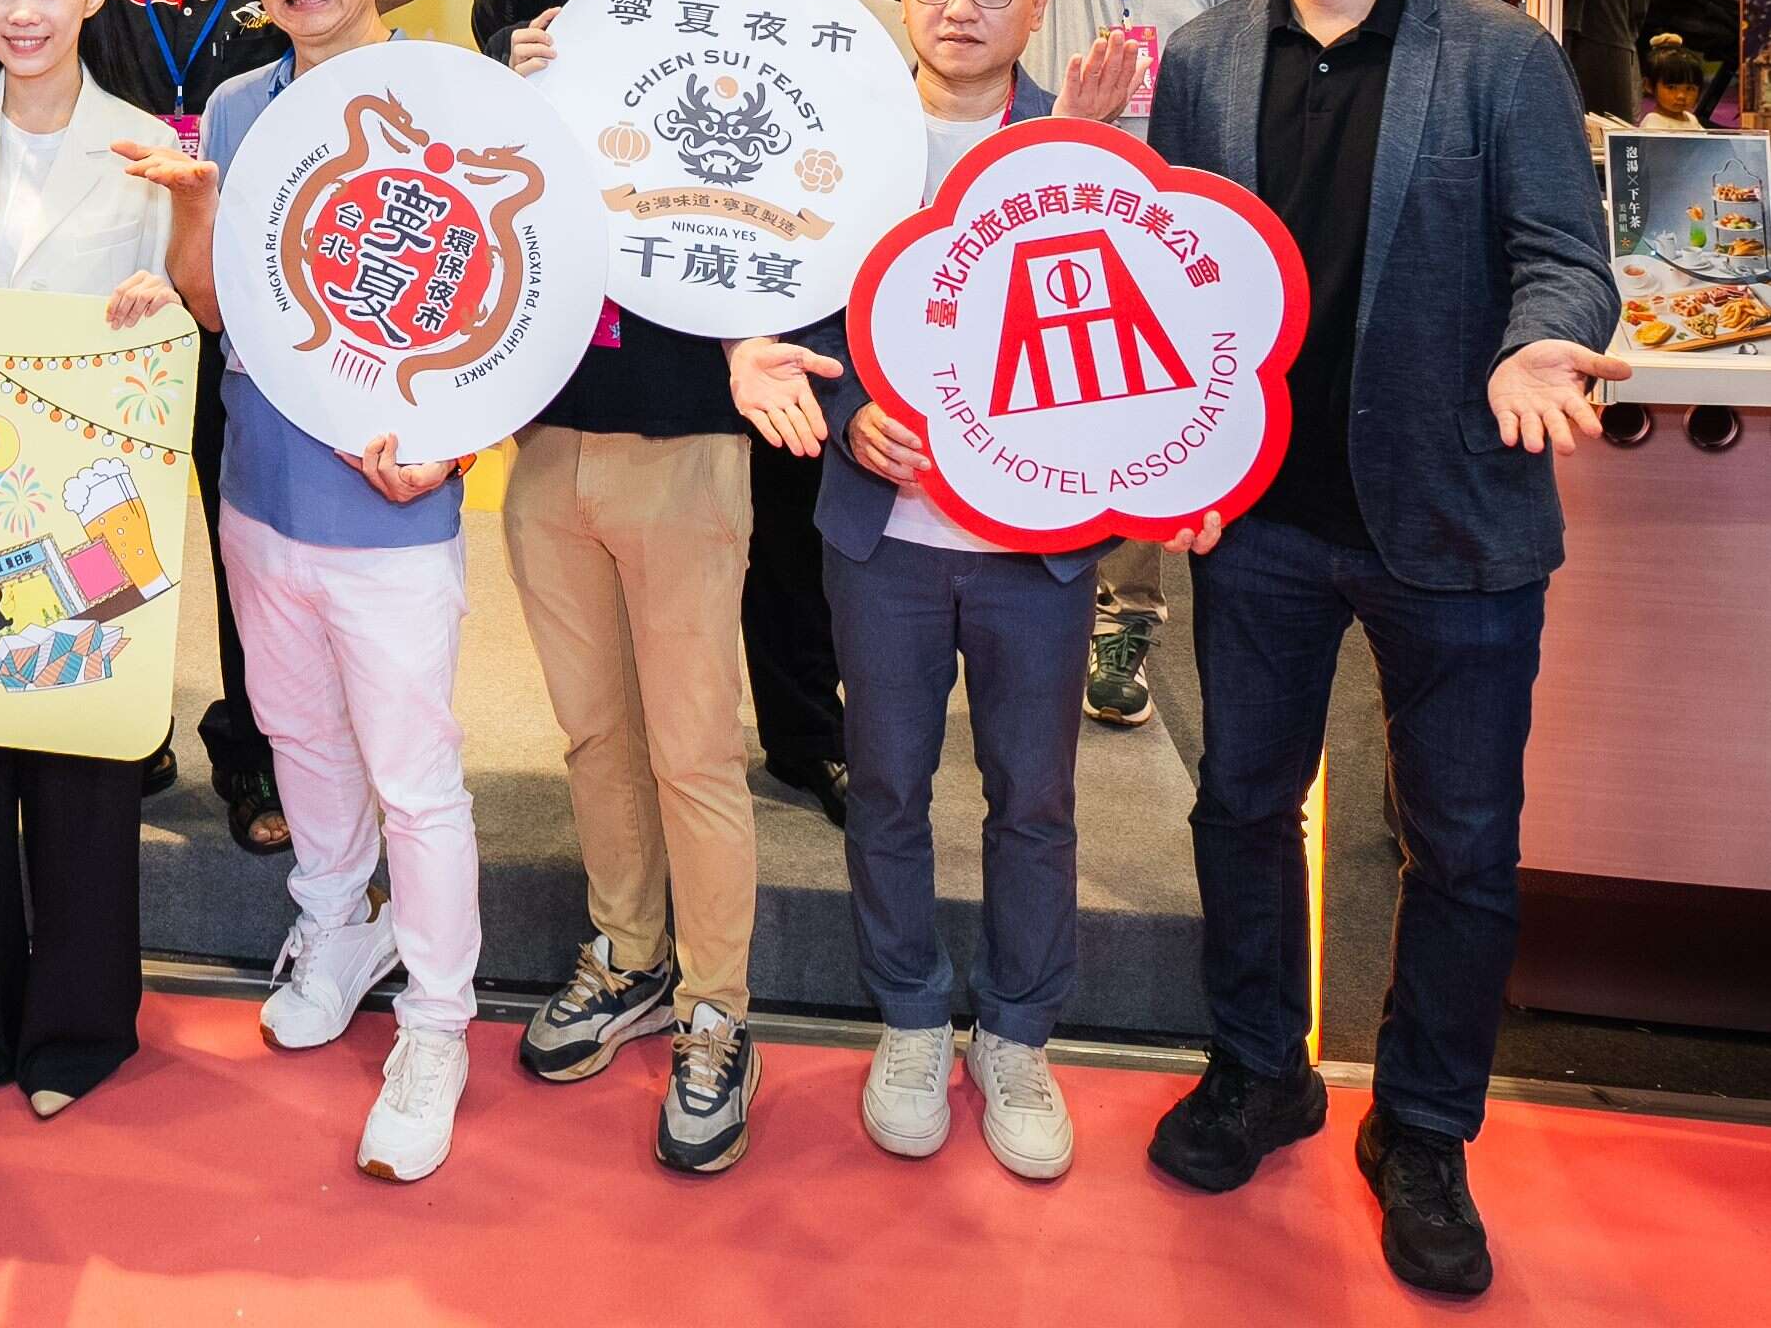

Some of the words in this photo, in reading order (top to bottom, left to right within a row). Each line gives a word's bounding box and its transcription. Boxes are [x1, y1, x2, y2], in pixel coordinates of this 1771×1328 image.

[623, 52, 695, 108] CHIEN
[704, 49, 750, 70] SUI
[757, 61, 824, 134] FEAST
[288, 143, 330, 186] MARKET
[270, 184, 291, 226] NIGHT
[319, 202, 363, 264] 台北
[672, 220, 728, 240] NINGXIA
[731, 228, 757, 243] YES
[265, 228, 277, 252] Rd.
[328, 180, 449, 345] 寧夏
[522, 224, 543, 288] NINGXIA
[620, 235, 803, 299] 千歲宴
[925, 181, 1222, 330] 臺北市旅館商業同業公會
[264, 254, 291, 312] NINGXIA
[416, 225, 478, 332] 環保夜市
[525, 289, 540, 311] Rd.
[504, 312, 533, 355] NIGHT
[453, 350, 506, 389] MARKET
[932, 362, 994, 453] TAIPEI
[992, 448, 1099, 495] HOTEL
[1108, 331, 1238, 493] ASSOCIATION
